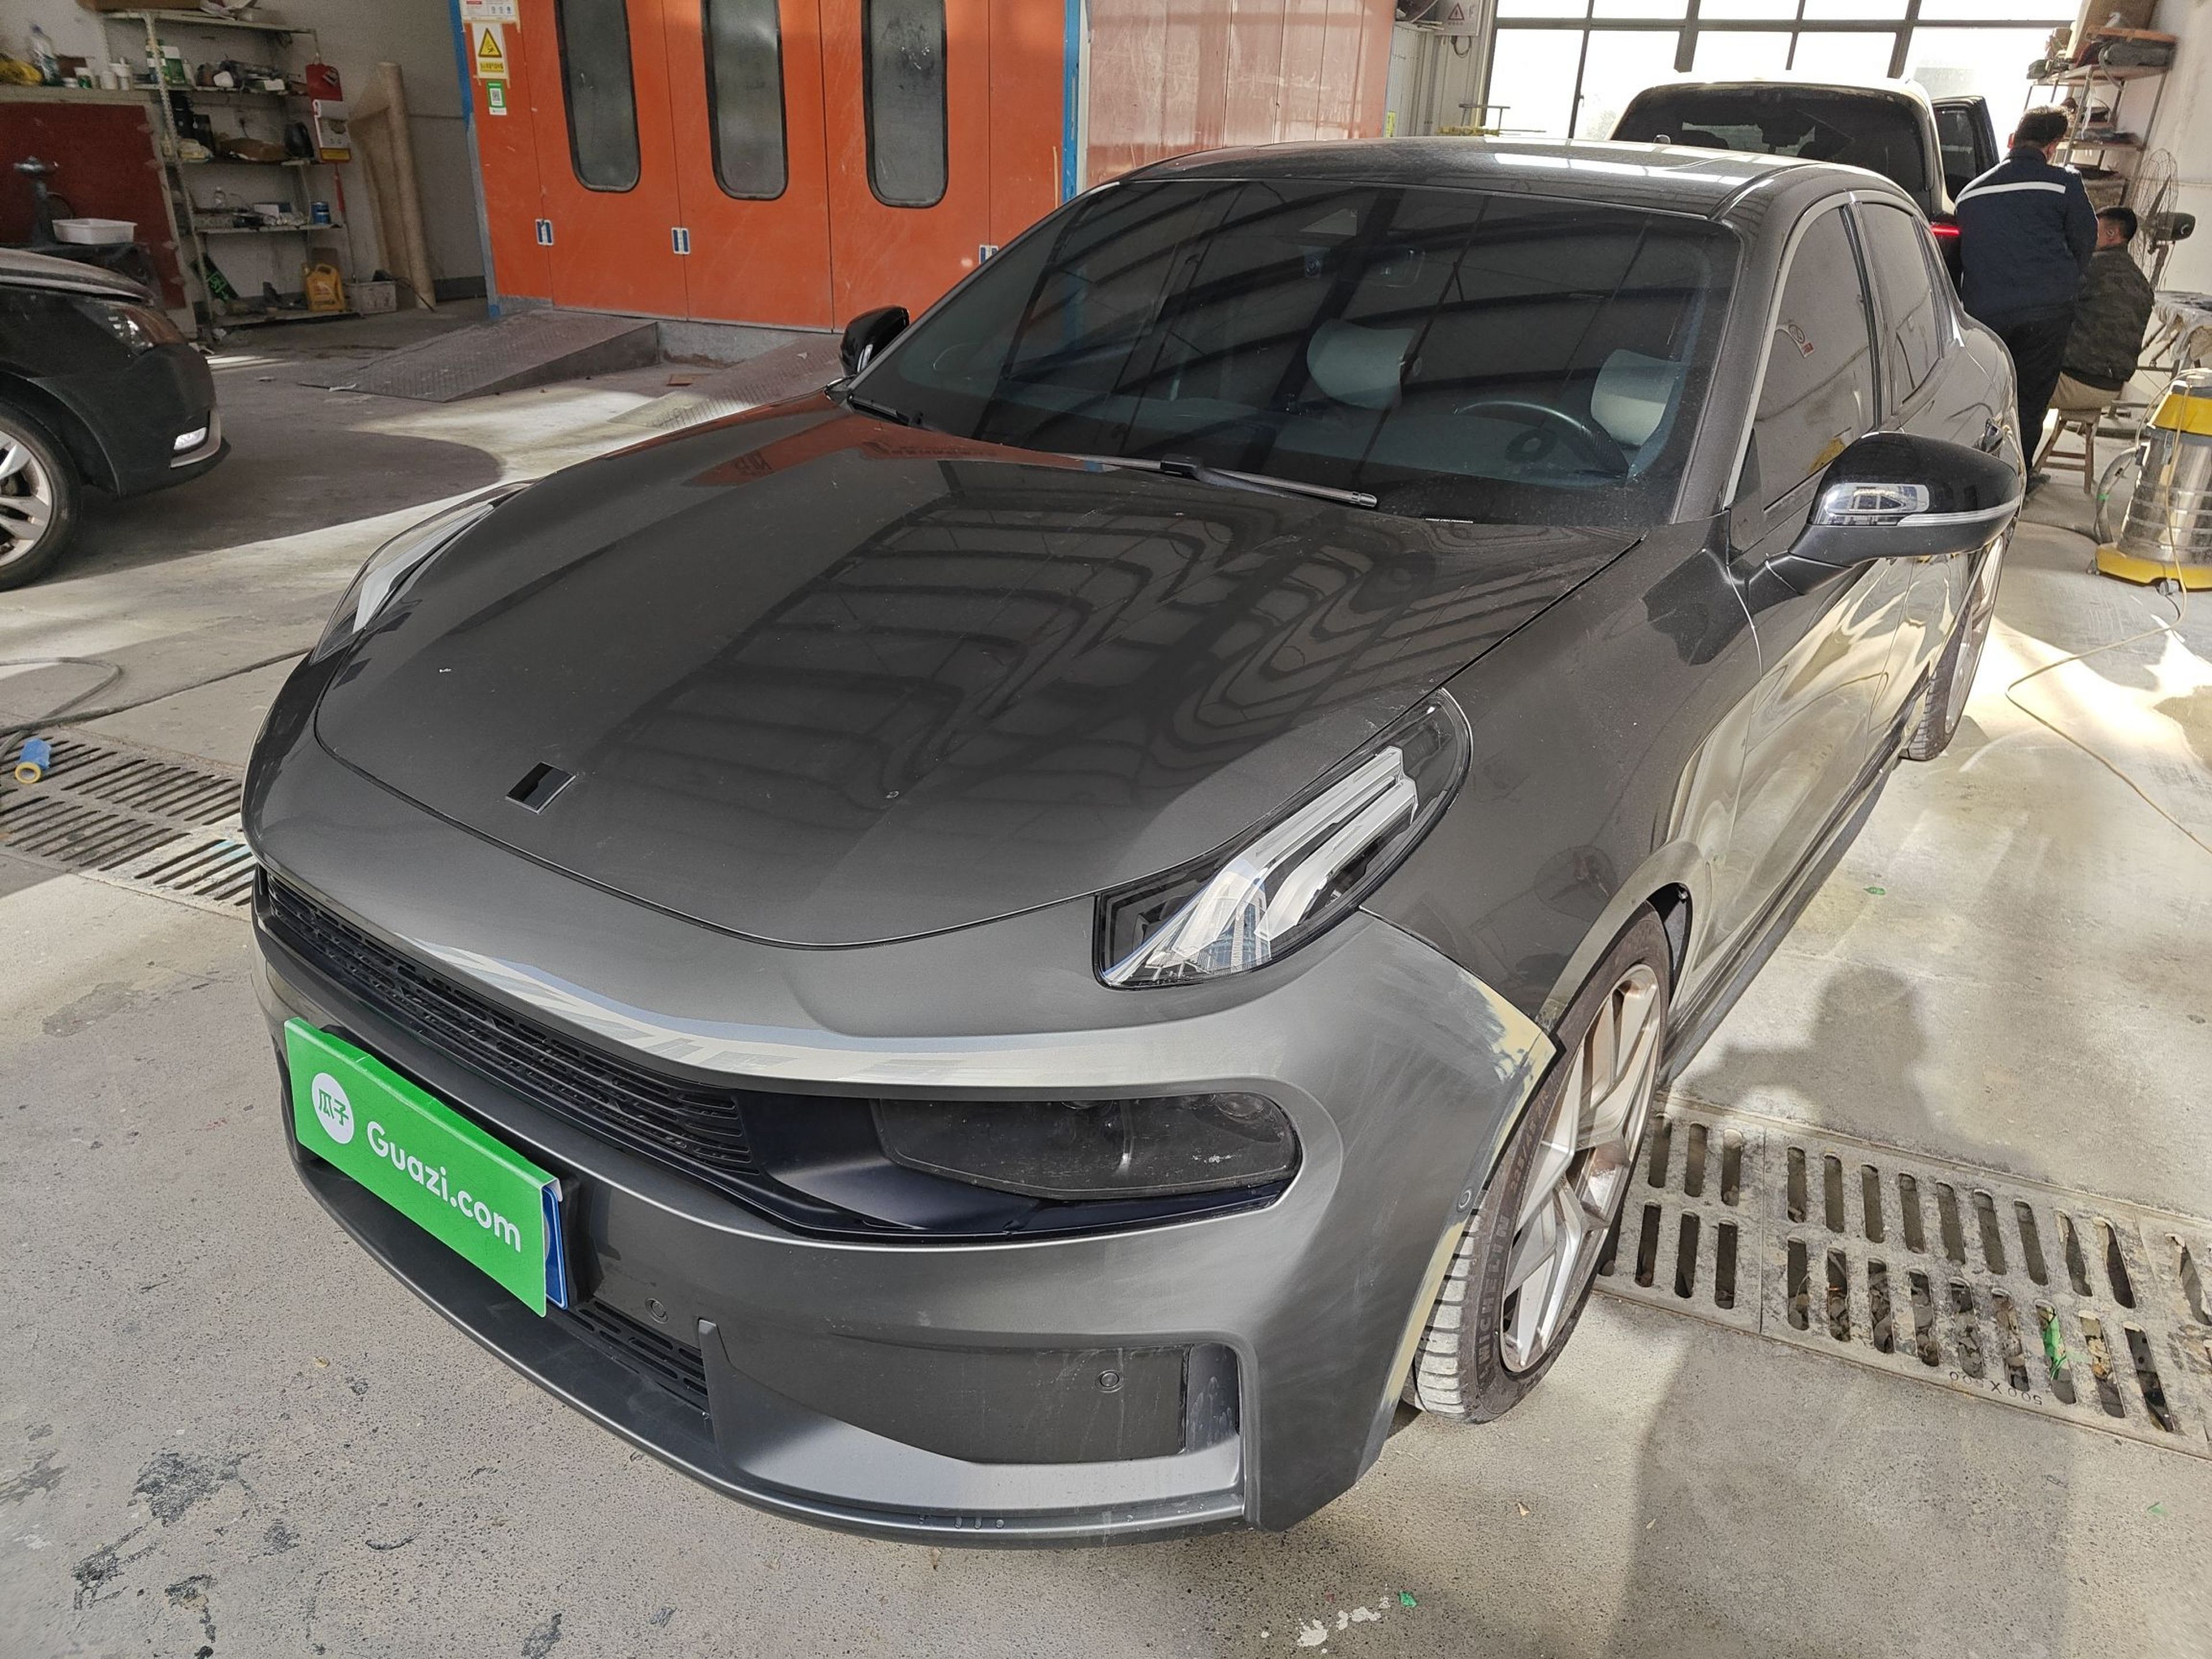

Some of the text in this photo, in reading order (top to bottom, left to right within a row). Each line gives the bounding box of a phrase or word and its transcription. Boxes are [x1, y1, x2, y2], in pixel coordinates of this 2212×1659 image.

[318, 1088, 349, 1126] 瓜子
[367, 1121, 521, 1252] Guazi.com
[1478, 1214, 1510, 1365] MICHELIN
